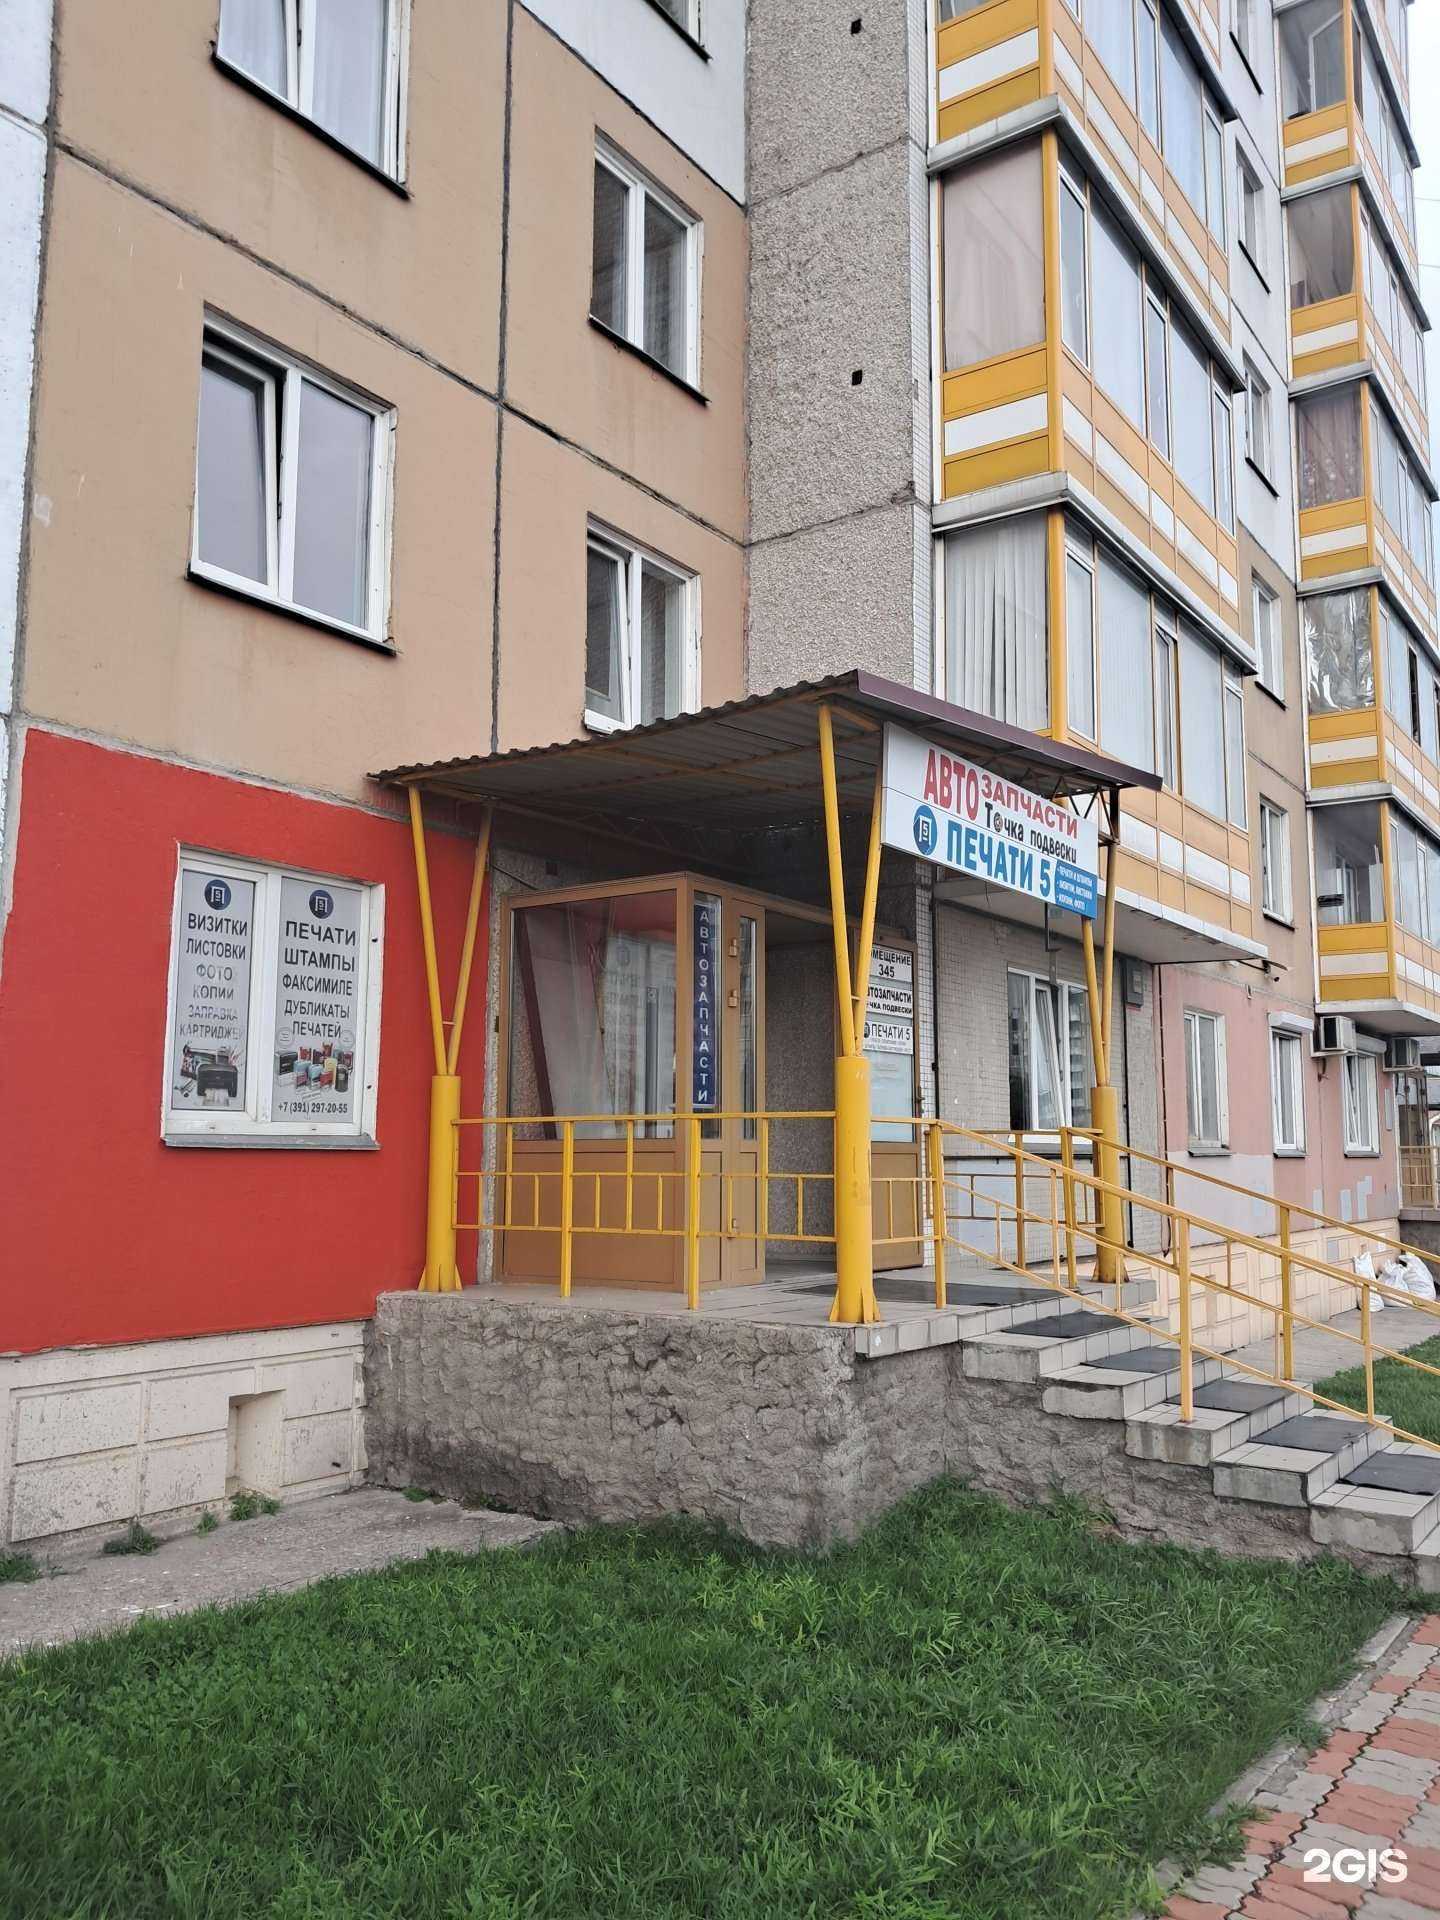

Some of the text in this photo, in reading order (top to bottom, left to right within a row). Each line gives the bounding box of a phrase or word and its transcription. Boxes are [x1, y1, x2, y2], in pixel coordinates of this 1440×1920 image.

[1030, 829, 1077, 864] подвески
[946, 819, 1051, 898] ПЕЧАТИ 5
[188, 912, 248, 937] ВИЗИТКИ
[285, 920, 356, 946] ПЕЧАТИ
[186, 937, 246, 960] ЛИСТОВКИ
[871, 948, 912, 966] МЕЩЕНИЕ
[284, 947, 355, 973] ШТАМПЫ
[878, 963, 895, 978] 345
[196, 963, 233, 981] ФОТО
[193, 984, 234, 1000] КОПИИ
[282, 973, 353, 996] ФАКСИМИЛЕ
[284, 999, 350, 1019] ДУБЛИКАТЫ
[698, 910, 709, 1102] АВТОЗАПЧАСТИ
[292, 1020, 341, 1038] ПЕЧАТЕЙ
[871, 1023, 904, 1040] ПЕЧАТИ
[905, 1028, 911, 1040] 5
[278, 1102, 348, 1115] +7 (391) 297-20-55
